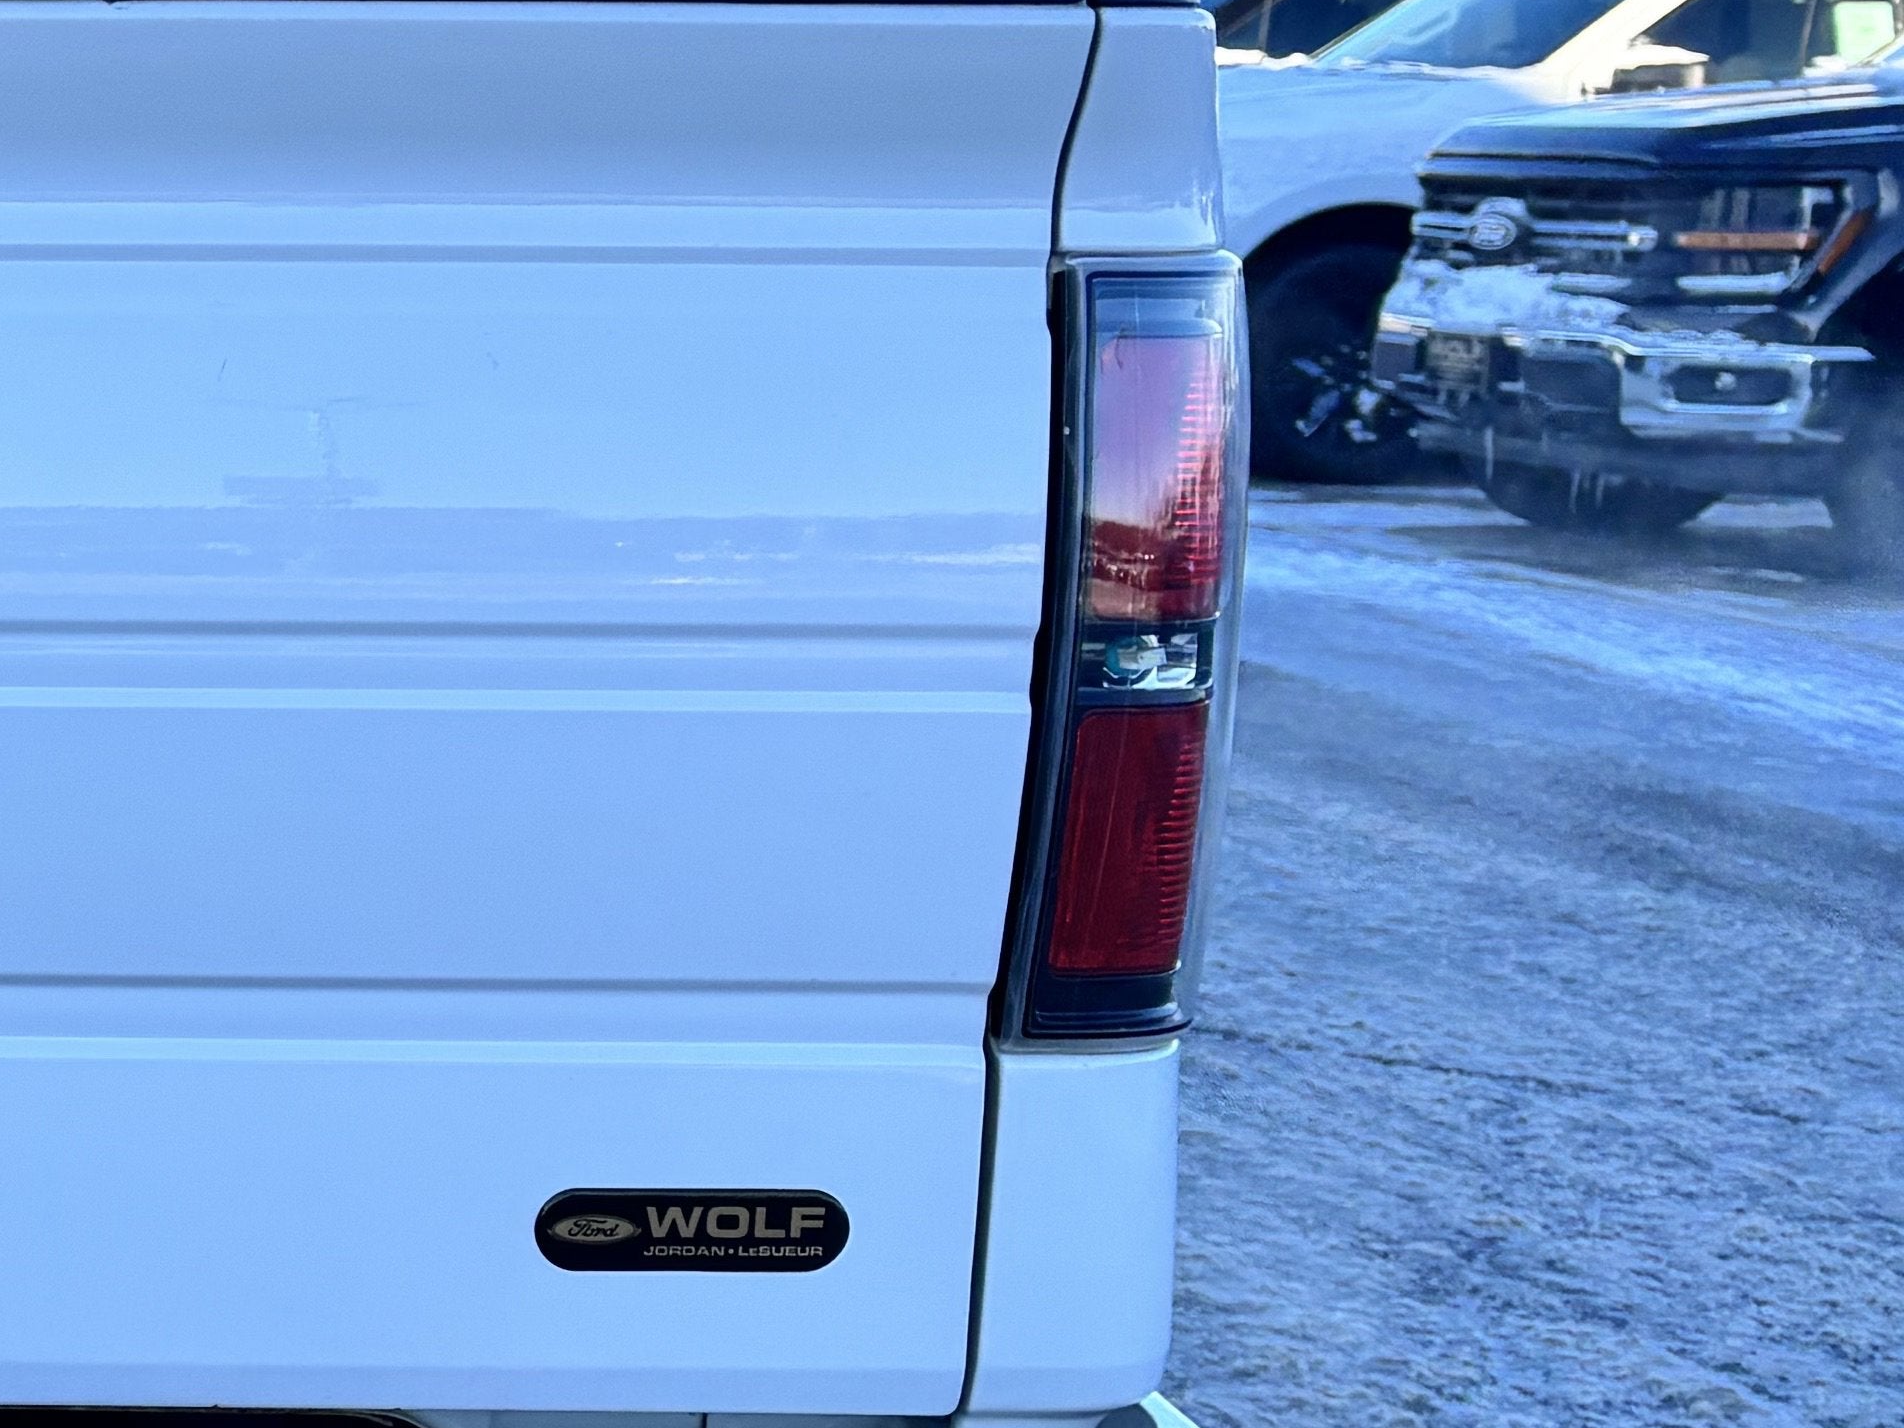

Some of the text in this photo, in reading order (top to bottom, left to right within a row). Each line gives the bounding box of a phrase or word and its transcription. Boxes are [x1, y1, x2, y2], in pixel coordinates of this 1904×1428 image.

[568, 1206, 826, 1238] Ford WOLF
[643, 1245, 724, 1257] JORDAN
